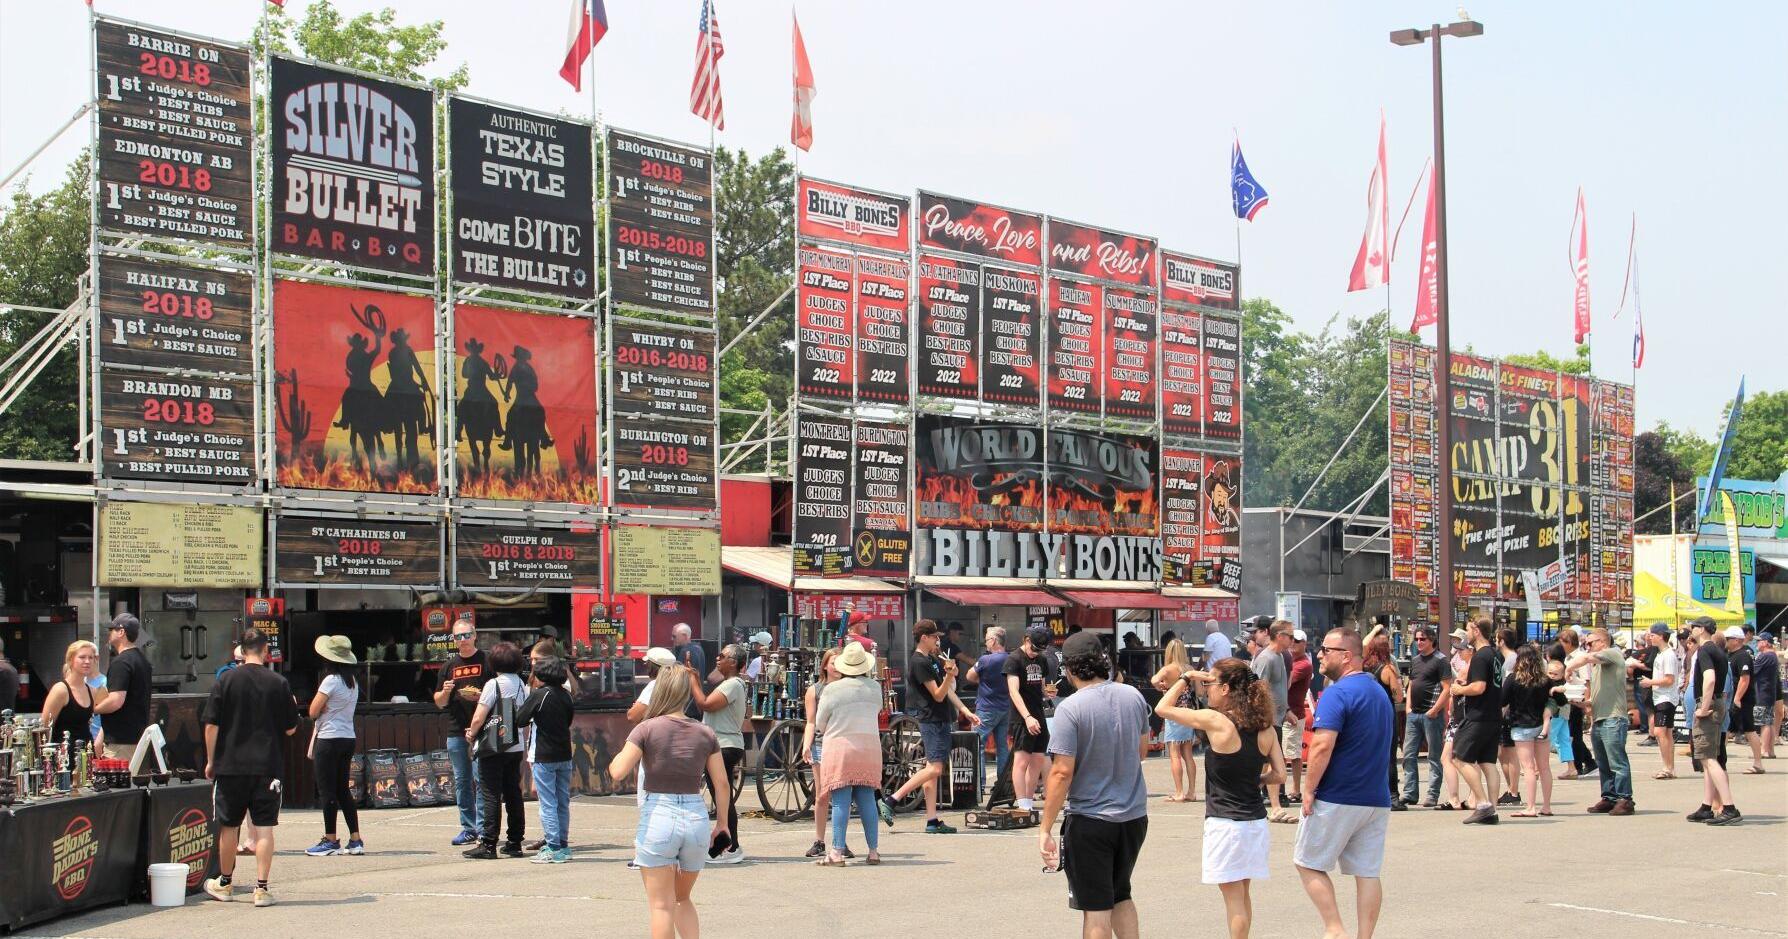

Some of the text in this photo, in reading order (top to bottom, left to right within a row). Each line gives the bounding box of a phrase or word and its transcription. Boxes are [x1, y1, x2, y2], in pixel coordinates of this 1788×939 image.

[127, 33, 220, 63] BARRIE ON
[139, 52, 212, 86] 2018
[106, 74, 237, 107] 1st Judge's Choice
[158, 96, 224, 118] BEST RIBS
[158, 109, 236, 132] BEST SAUCE
[284, 82, 419, 173] SILVER
[491, 113, 557, 139] AUTHENTIC
[122, 116, 243, 146] BEST PULLED PORK
[115, 139, 233, 170] EDMONTON AB
[479, 129, 565, 168] TEXAS
[616, 139, 704, 168] BROCKVILLE ON
[138, 160, 212, 192] 2018
[481, 161, 565, 198] STYLE
[640, 159, 683, 183] 2018
[106, 183, 237, 211] 1st Judge's Choice
[285, 166, 422, 233] BULLET
[158, 206, 236, 226] BEST SAUCE
[855, 204, 898, 228] BONES
[123, 214, 244, 240] BEST PULLED PORK
[459, 216, 581, 256] COME BITE
[925, 204, 1036, 254] Peace, Love
[618, 227, 706, 257] 2015-2018
[1052, 242, 1149, 274] and Ribs!
[461, 251, 570, 286] THE BULLET
[126, 272, 226, 296] HALIFAX NS
[804, 272, 849, 290] 1ST Place
[986, 273, 1037, 294] MUSKOKA
[1200, 270, 1232, 290] BONES
[651, 292, 709, 308] BEST CHICKEN
[862, 282, 904, 299] 1ST Place
[929, 287, 969, 303] 1ST Place
[1060, 287, 1091, 304] HALIFAX
[142, 290, 213, 320] 2018
[806, 296, 846, 312] JUDGE'S
[864, 306, 901, 321] JUDGE'S
[931, 304, 966, 320] JUDGE'S
[993, 298, 1031, 312] 1ST Place
[1106, 294, 1155, 314] SUMMERSIDE
[809, 313, 844, 328] CHOICE
[1058, 308, 1093, 323] 1ST Place
[867, 324, 899, 337] CHOICE
[933, 320, 965, 336] CHOICE
[992, 320, 1031, 336] PEOPLE'S
[632, 333, 694, 349] WHITBY ON
[996, 336, 1026, 350] CHOICE
[1061, 337, 1089, 352] CHOICE
[618, 346, 707, 372] 2016-2018
[806, 347, 845, 363] & SAUCE
[931, 352, 966, 368] & SAUCE
[1117, 353, 1143, 367] CHOICE
[813, 368, 839, 383] 2022
[871, 369, 896, 383] 2022
[936, 370, 960, 383] 2022
[1000, 375, 1022, 387] 2022
[1517, 376, 1556, 392] FINEST
[122, 380, 233, 400] BRANDON MB
[1064, 386, 1085, 399] 2022
[1121, 390, 1140, 402] 2022
[144, 399, 214, 425] 2018
[620, 429, 707, 446] BURLINGTON ON
[800, 421, 849, 441] MONTREAL
[858, 427, 906, 445] BURLINGTON
[642, 445, 688, 465] 2018
[931, 427, 1037, 473] WORLD
[1530, 397, 1583, 519] 31
[618, 468, 707, 490] 2nd Judge's Choice
[804, 469, 844, 483] JUDGE'S
[312, 527, 406, 539] ST CATHARINES ON
[503, 536, 553, 545] GUELPH ON
[1465, 531, 1482, 544] THE
[482, 544, 519, 558] 2016
[538, 547, 574, 560] 2018
[877, 539, 908, 549] GLUTEN
[1504, 536, 1529, 552] DIXIE
[883, 553, 903, 563] FREE
[932, 529, 1064, 578] BILLY
[1075, 535, 1163, 581] BONES
[1223, 562, 1241, 578] BEEF
[1222, 576, 1240, 590] RIBS
[1382, 600, 1399, 611] BBQ
[952, 771, 973, 783] ULLET
[53, 829, 92, 860] BONE
[170, 822, 207, 848] BONE
[53, 841, 98, 884] DADDY'S
[189, 859, 203, 873] BQ
[64, 869, 85, 889] BBQ
